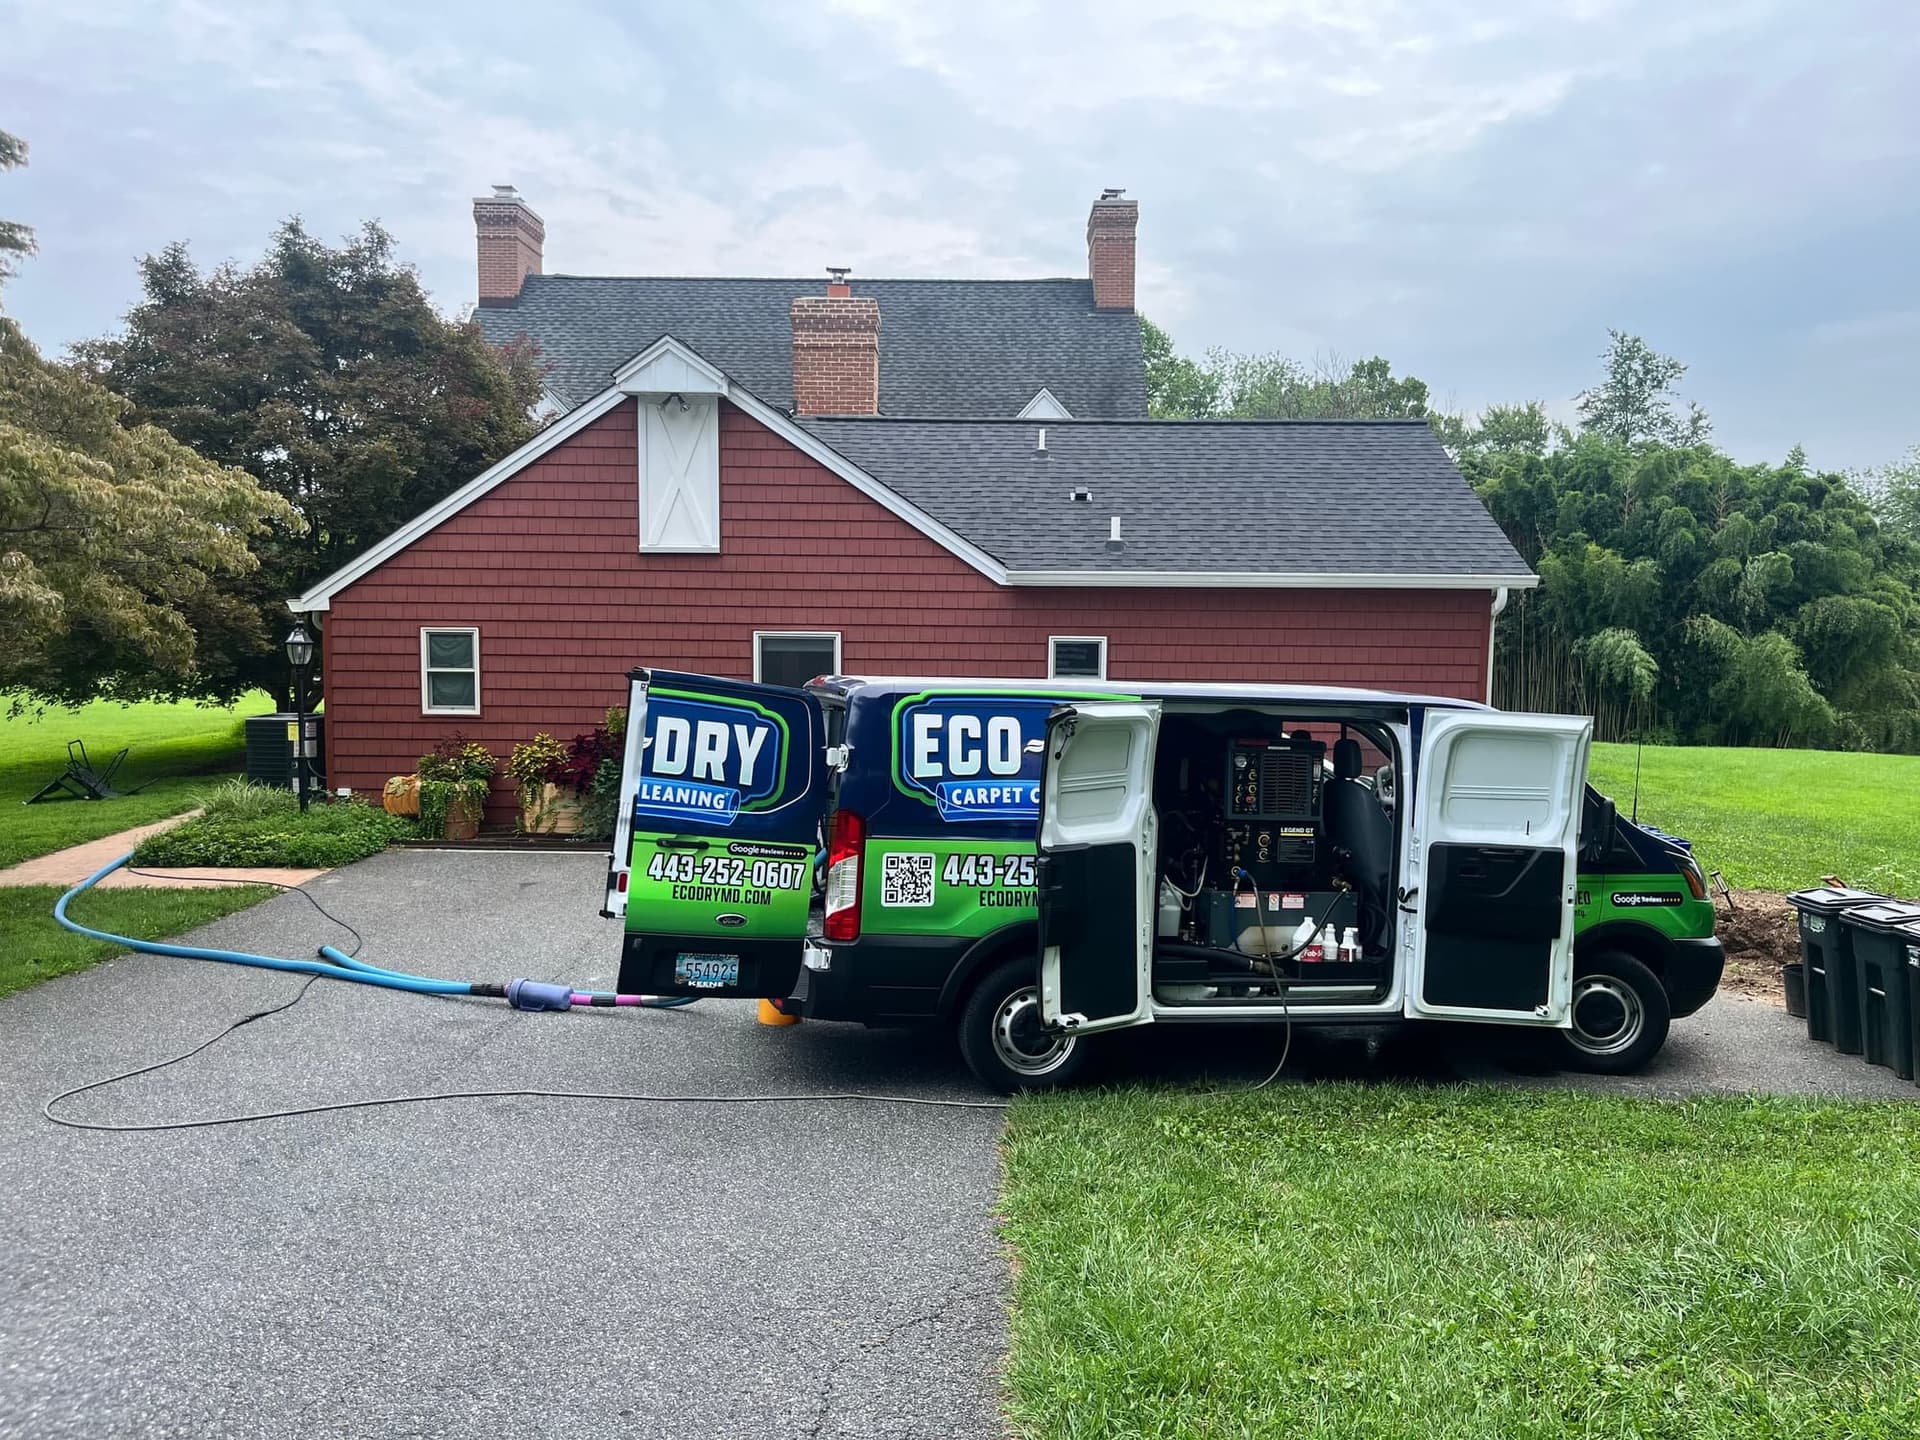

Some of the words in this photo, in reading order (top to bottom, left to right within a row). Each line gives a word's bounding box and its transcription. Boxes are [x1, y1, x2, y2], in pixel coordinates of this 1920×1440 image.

[951, 787, 1023, 805] CARPET
[729, 843, 760, 857] Google
[647, 852, 806, 890] 443-252-0607
[942, 853, 1039, 887] 443-25
[672, 884, 772, 906] ECODRYMD.COM
[1613, 893, 1641, 906] Google
